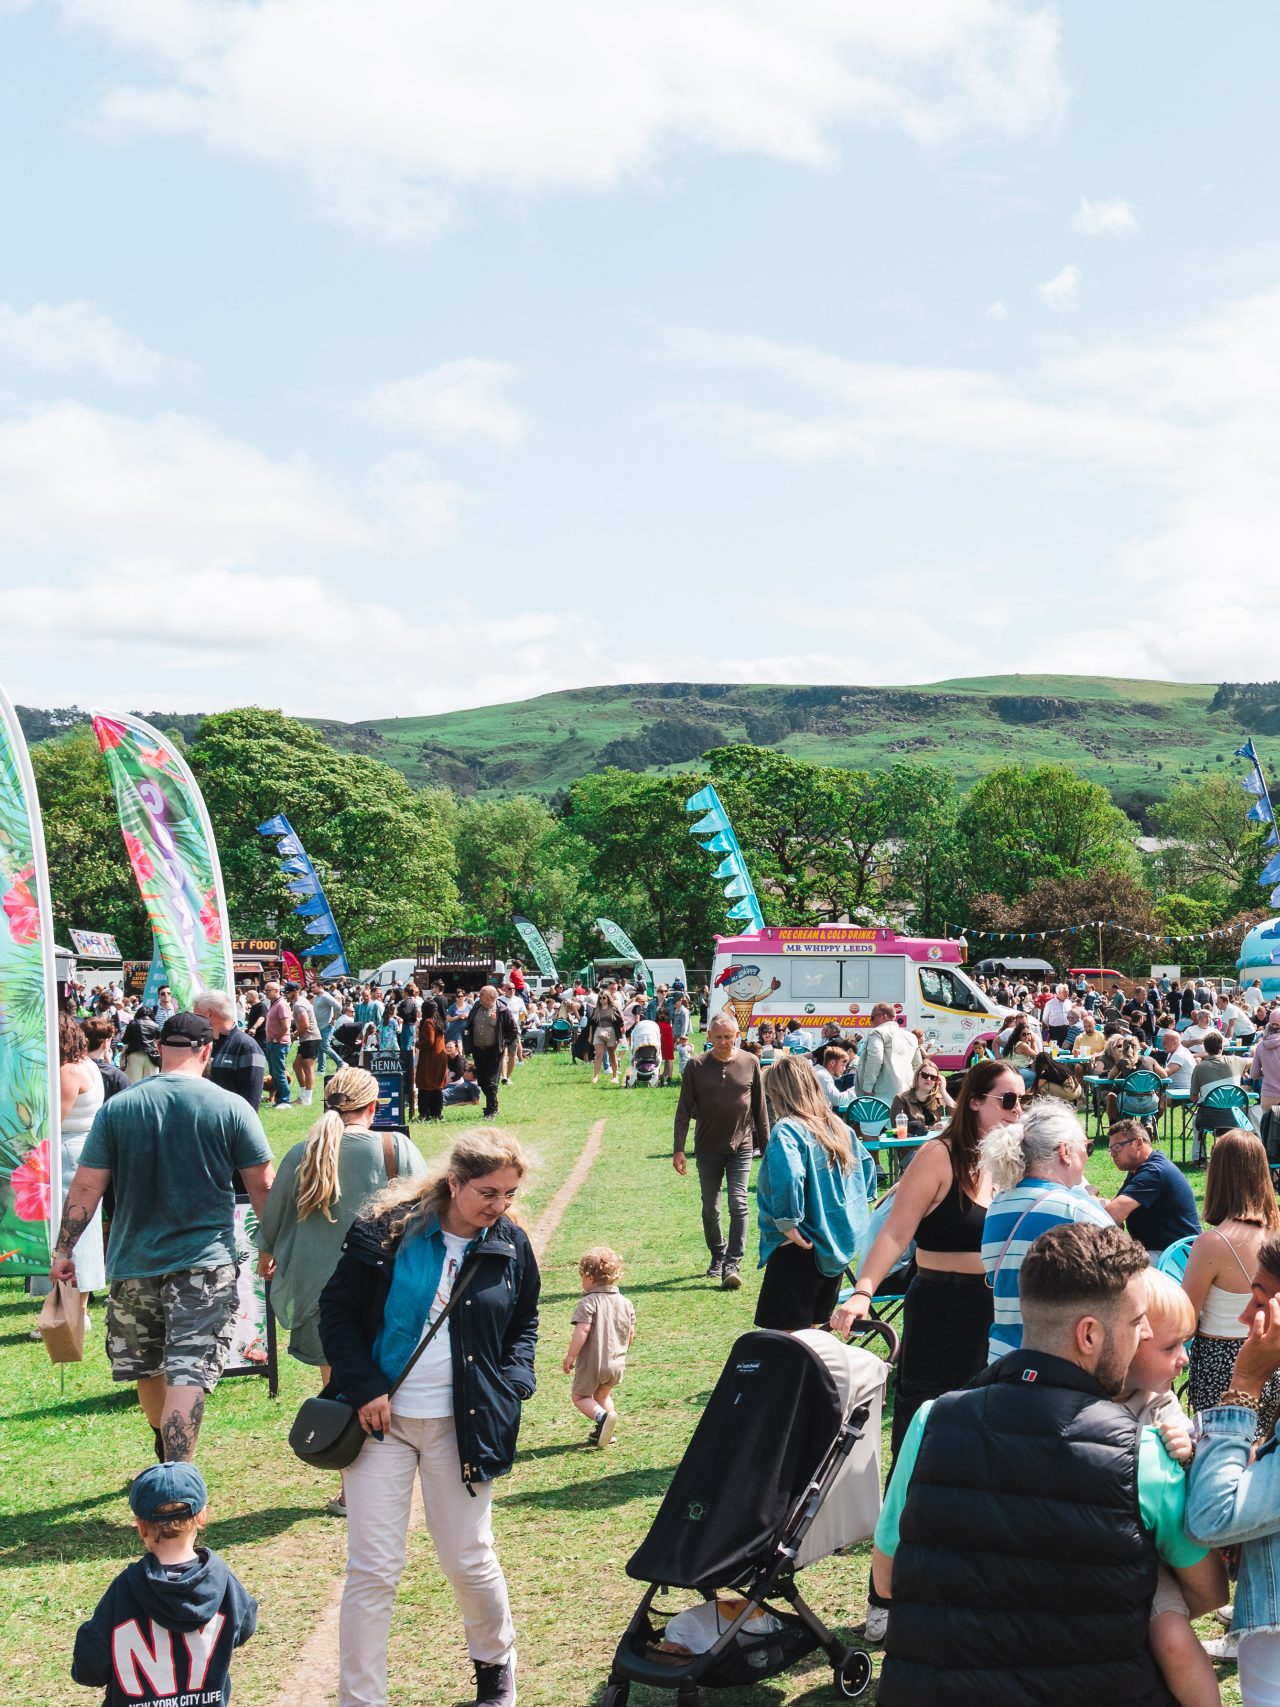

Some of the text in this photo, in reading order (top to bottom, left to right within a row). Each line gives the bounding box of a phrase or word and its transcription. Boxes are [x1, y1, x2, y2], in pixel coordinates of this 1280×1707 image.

[779, 929, 877, 940] ICE CREAM & COLD DRINKS
[249, 941, 277, 950] FOOD
[786, 944, 873, 952] MR WHIPPY LEEDS
[840, 1016, 857, 1026] ICE
[858, 1016, 872, 1026] CR
[370, 1060, 403, 1071] HENNA
[111, 1611, 227, 1697] NY
[180, 1694, 201, 1707] CITY
[202, 1690, 222, 1704] LIFE
